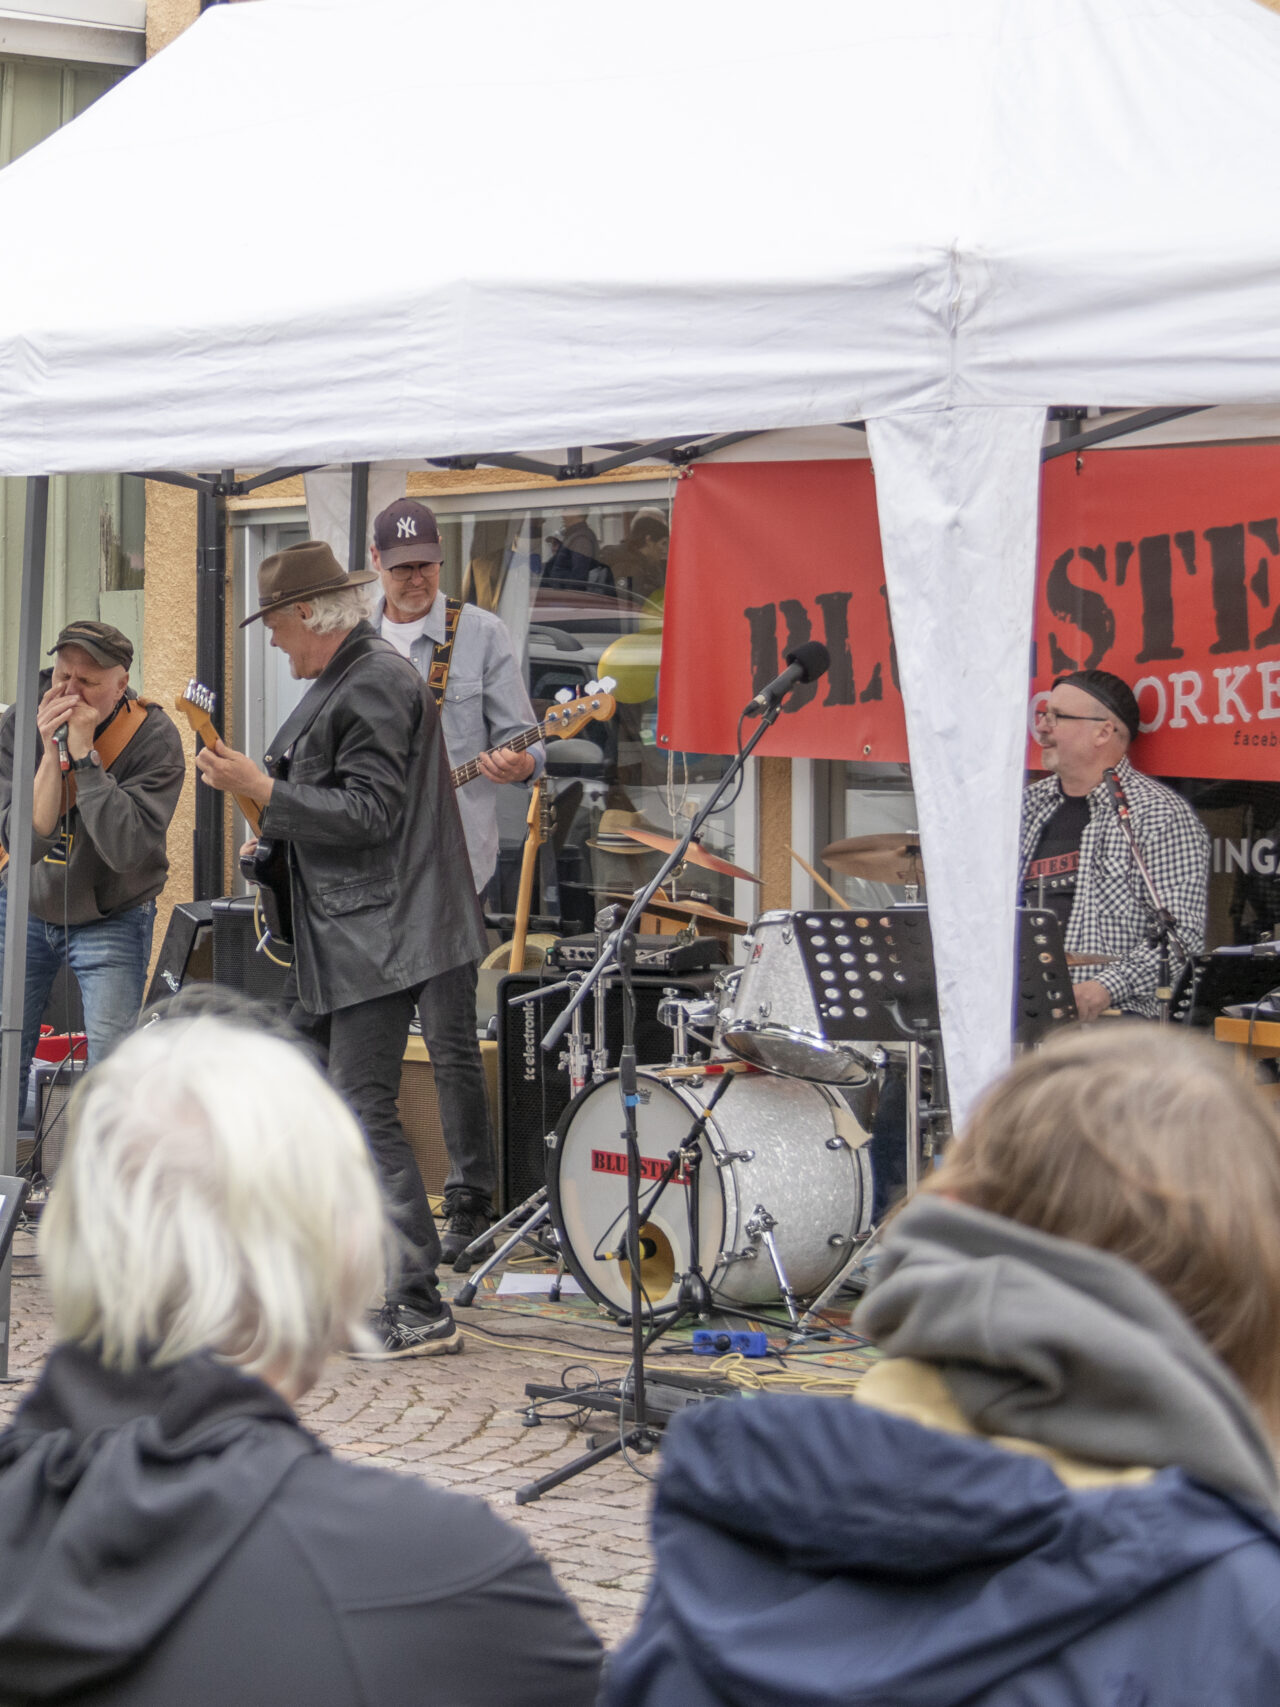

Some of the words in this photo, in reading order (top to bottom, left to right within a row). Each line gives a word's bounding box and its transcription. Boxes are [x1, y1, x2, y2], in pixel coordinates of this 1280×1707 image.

[396, 516, 418, 538] NY
[1214, 837, 1280, 874] ING
[523, 1000, 536, 1066] electronic
